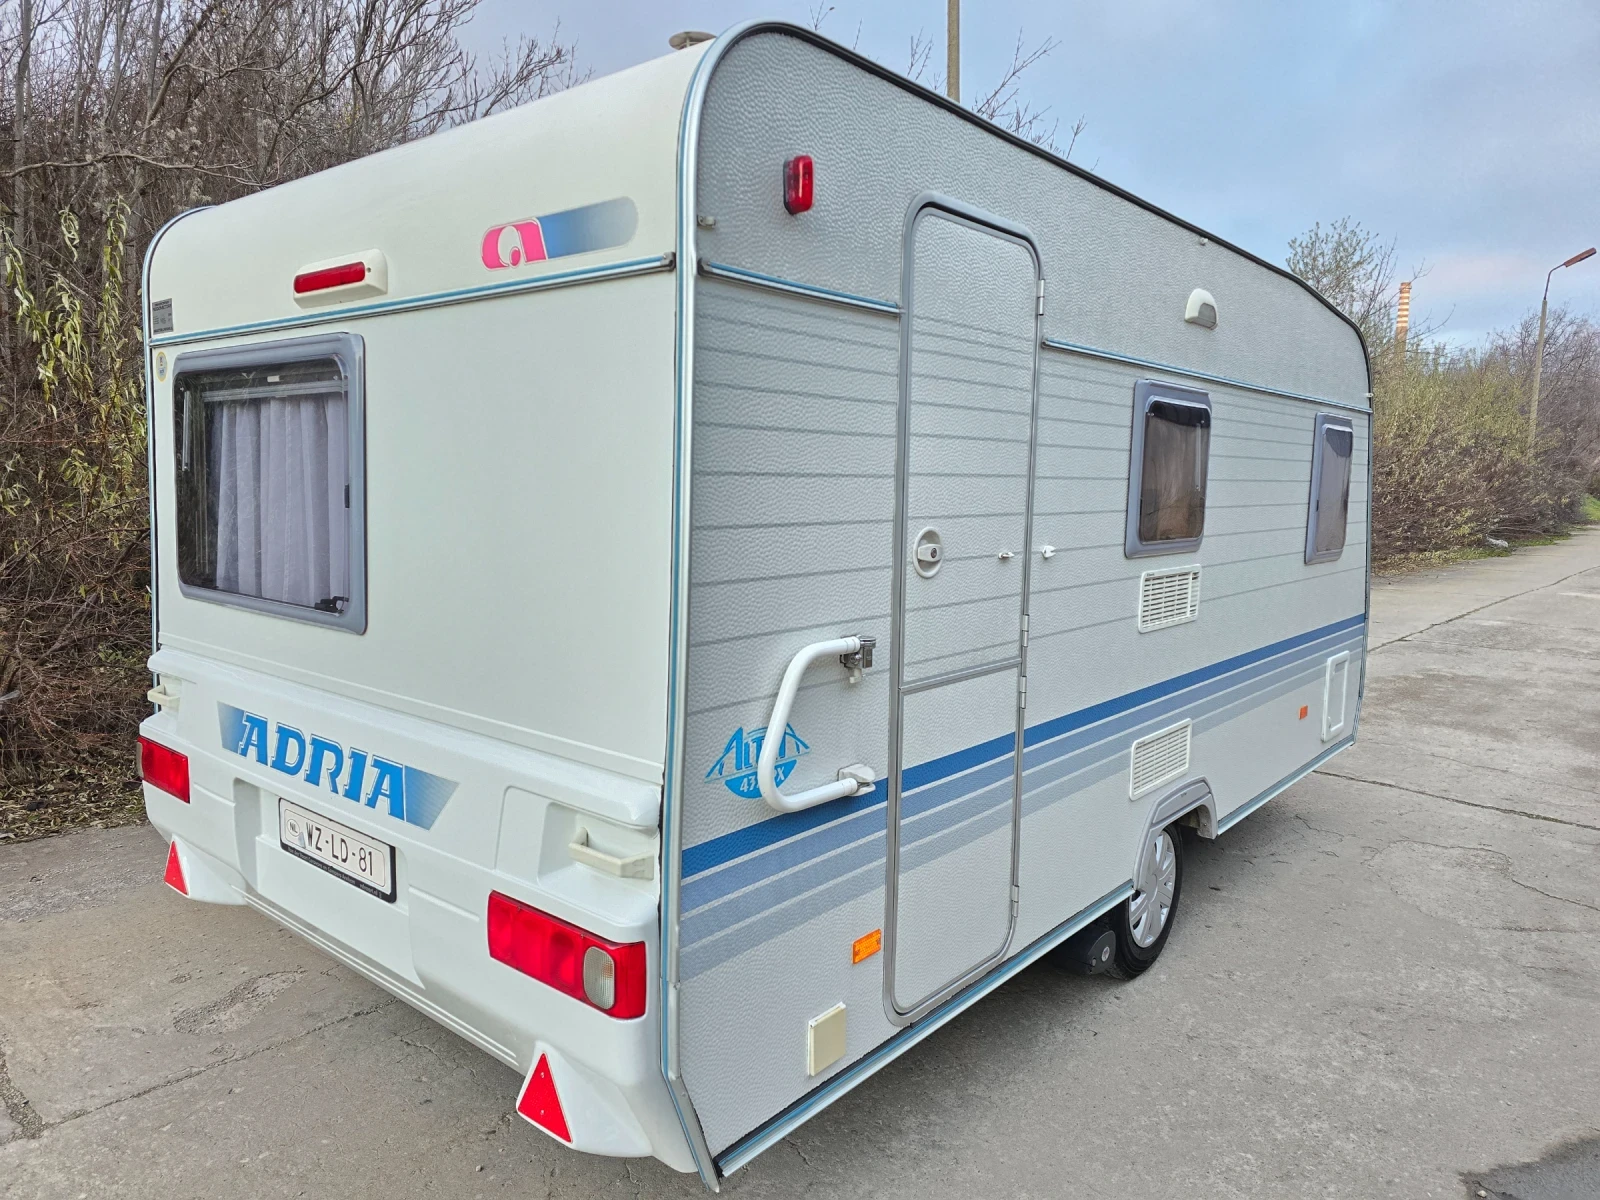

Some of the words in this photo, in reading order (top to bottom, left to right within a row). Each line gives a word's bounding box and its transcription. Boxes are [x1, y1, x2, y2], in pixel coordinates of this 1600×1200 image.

[238, 711, 406, 821] ADRIA
[705, 722, 810, 778] ALTA
[289, 822, 298, 834] NL
[306, 822, 373, 876] WZ-LD-81
